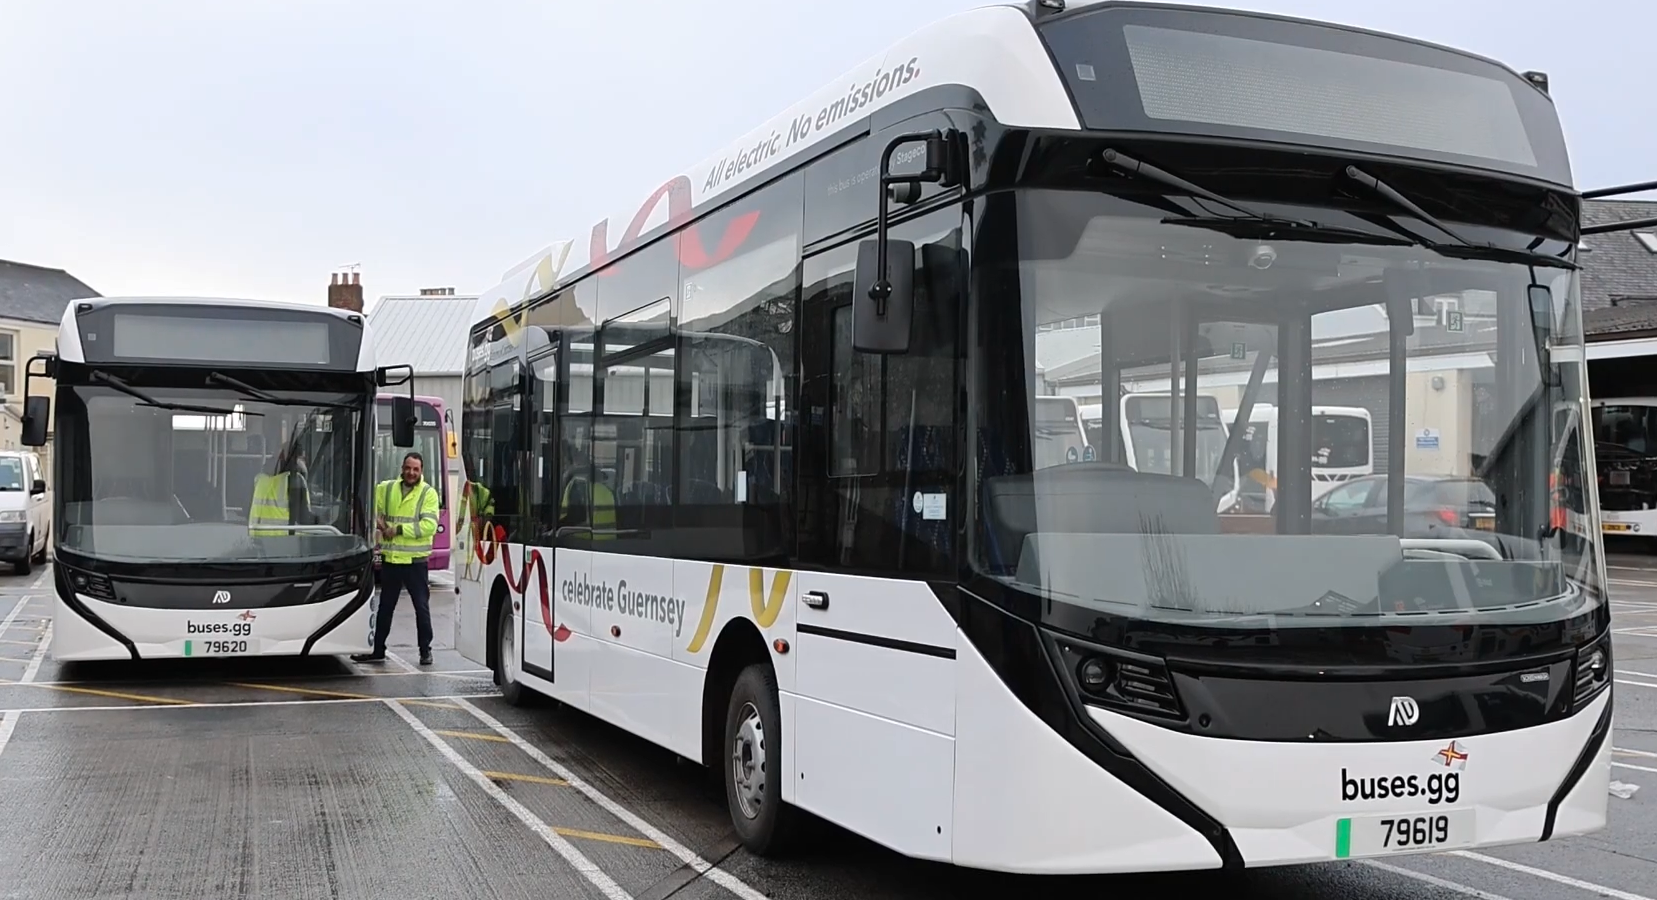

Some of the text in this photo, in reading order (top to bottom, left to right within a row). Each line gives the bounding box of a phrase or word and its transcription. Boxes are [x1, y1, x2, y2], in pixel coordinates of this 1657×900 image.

[702, 155, 725, 193] All
[786, 113, 812, 148] No
[815, 57, 920, 131] emissions.
[827, 183, 838, 196] this
[839, 178, 850, 191] bus
[851, 174, 857, 185] is
[562, 571, 685, 638] celebrate Guernsey
[187, 620, 251, 636] buses.gg
[204, 641, 247, 653] 79620
[1341, 768, 1460, 804] buses.gg
[1380, 815, 1449, 848] 79619
